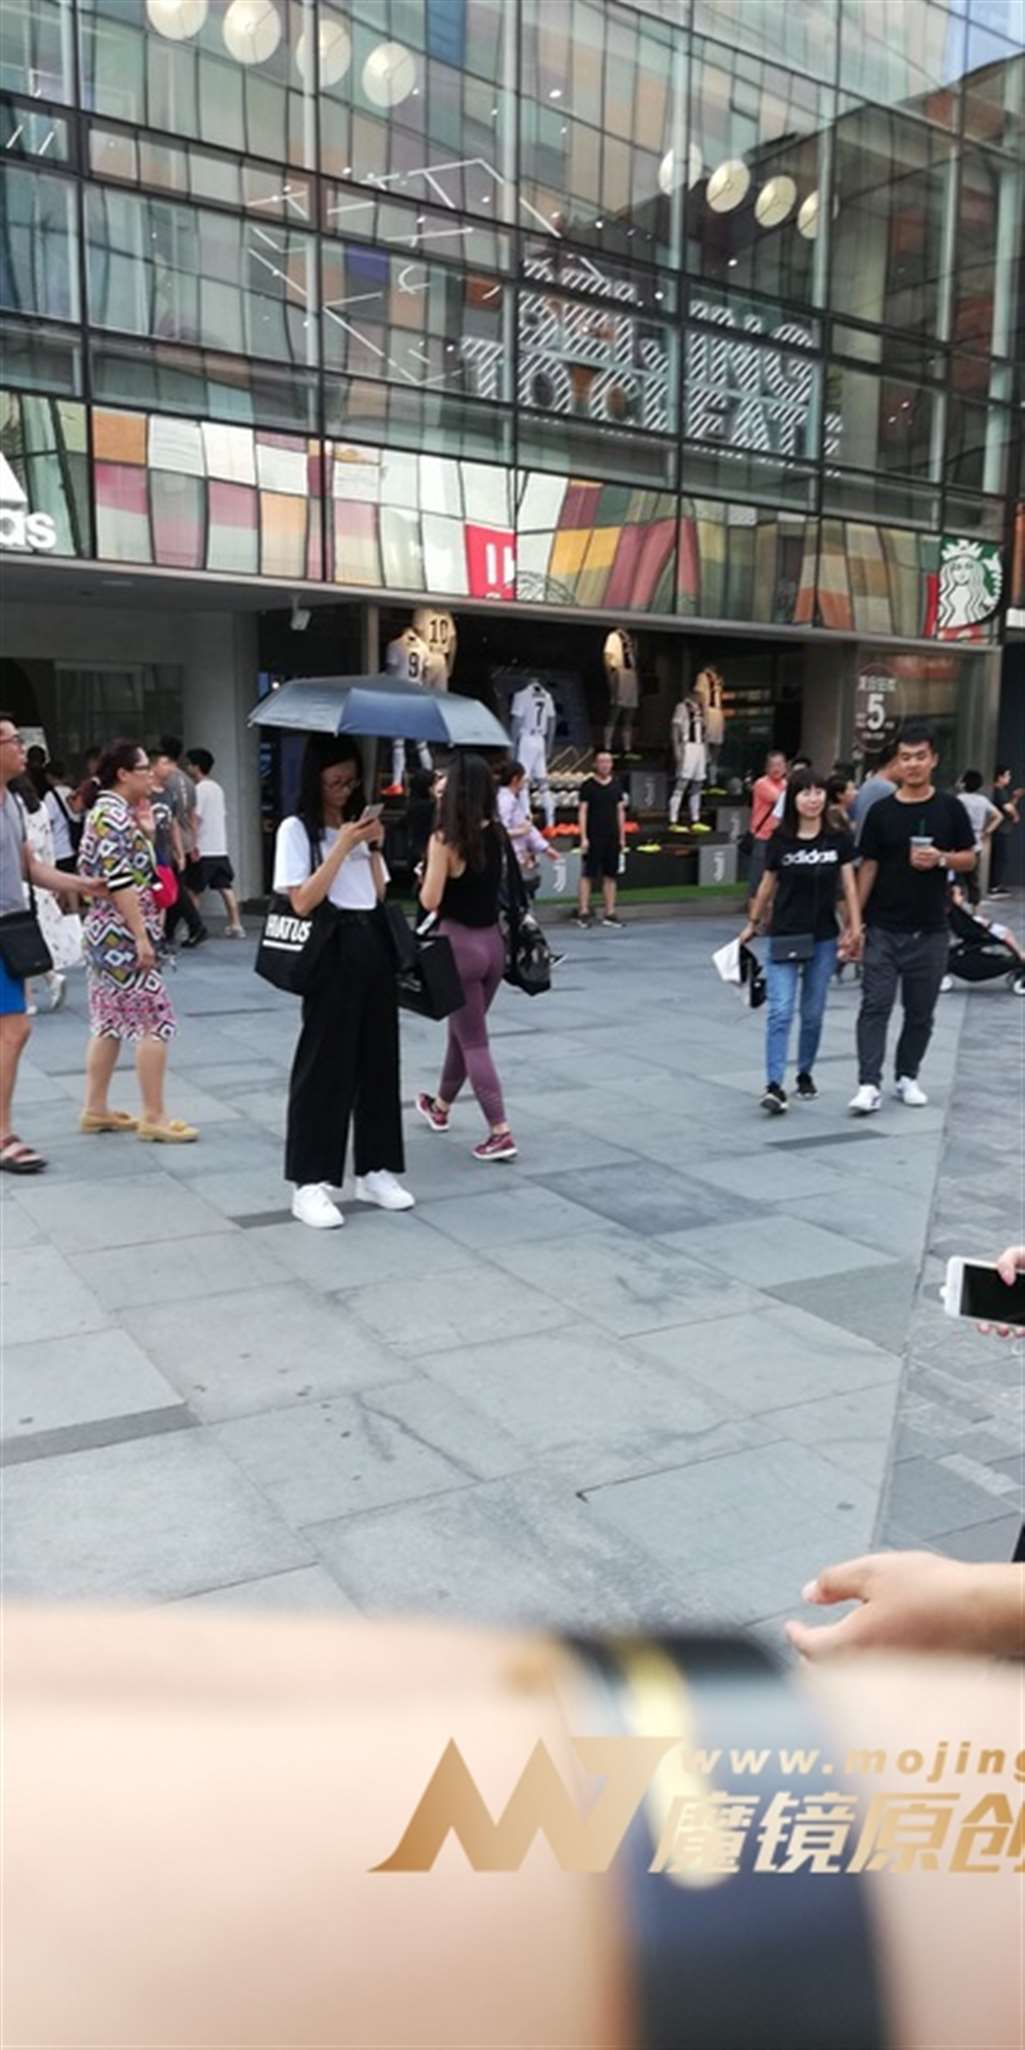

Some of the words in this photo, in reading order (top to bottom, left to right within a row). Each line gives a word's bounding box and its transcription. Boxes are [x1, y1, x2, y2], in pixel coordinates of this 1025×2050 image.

[461, 336, 574, 424] TO
[428, 619, 449, 645] 10
[408, 652, 420, 678] 9
[534, 700, 545, 727] 7
[867, 693, 886, 731] 5
[781, 849, 839, 866] adidas
